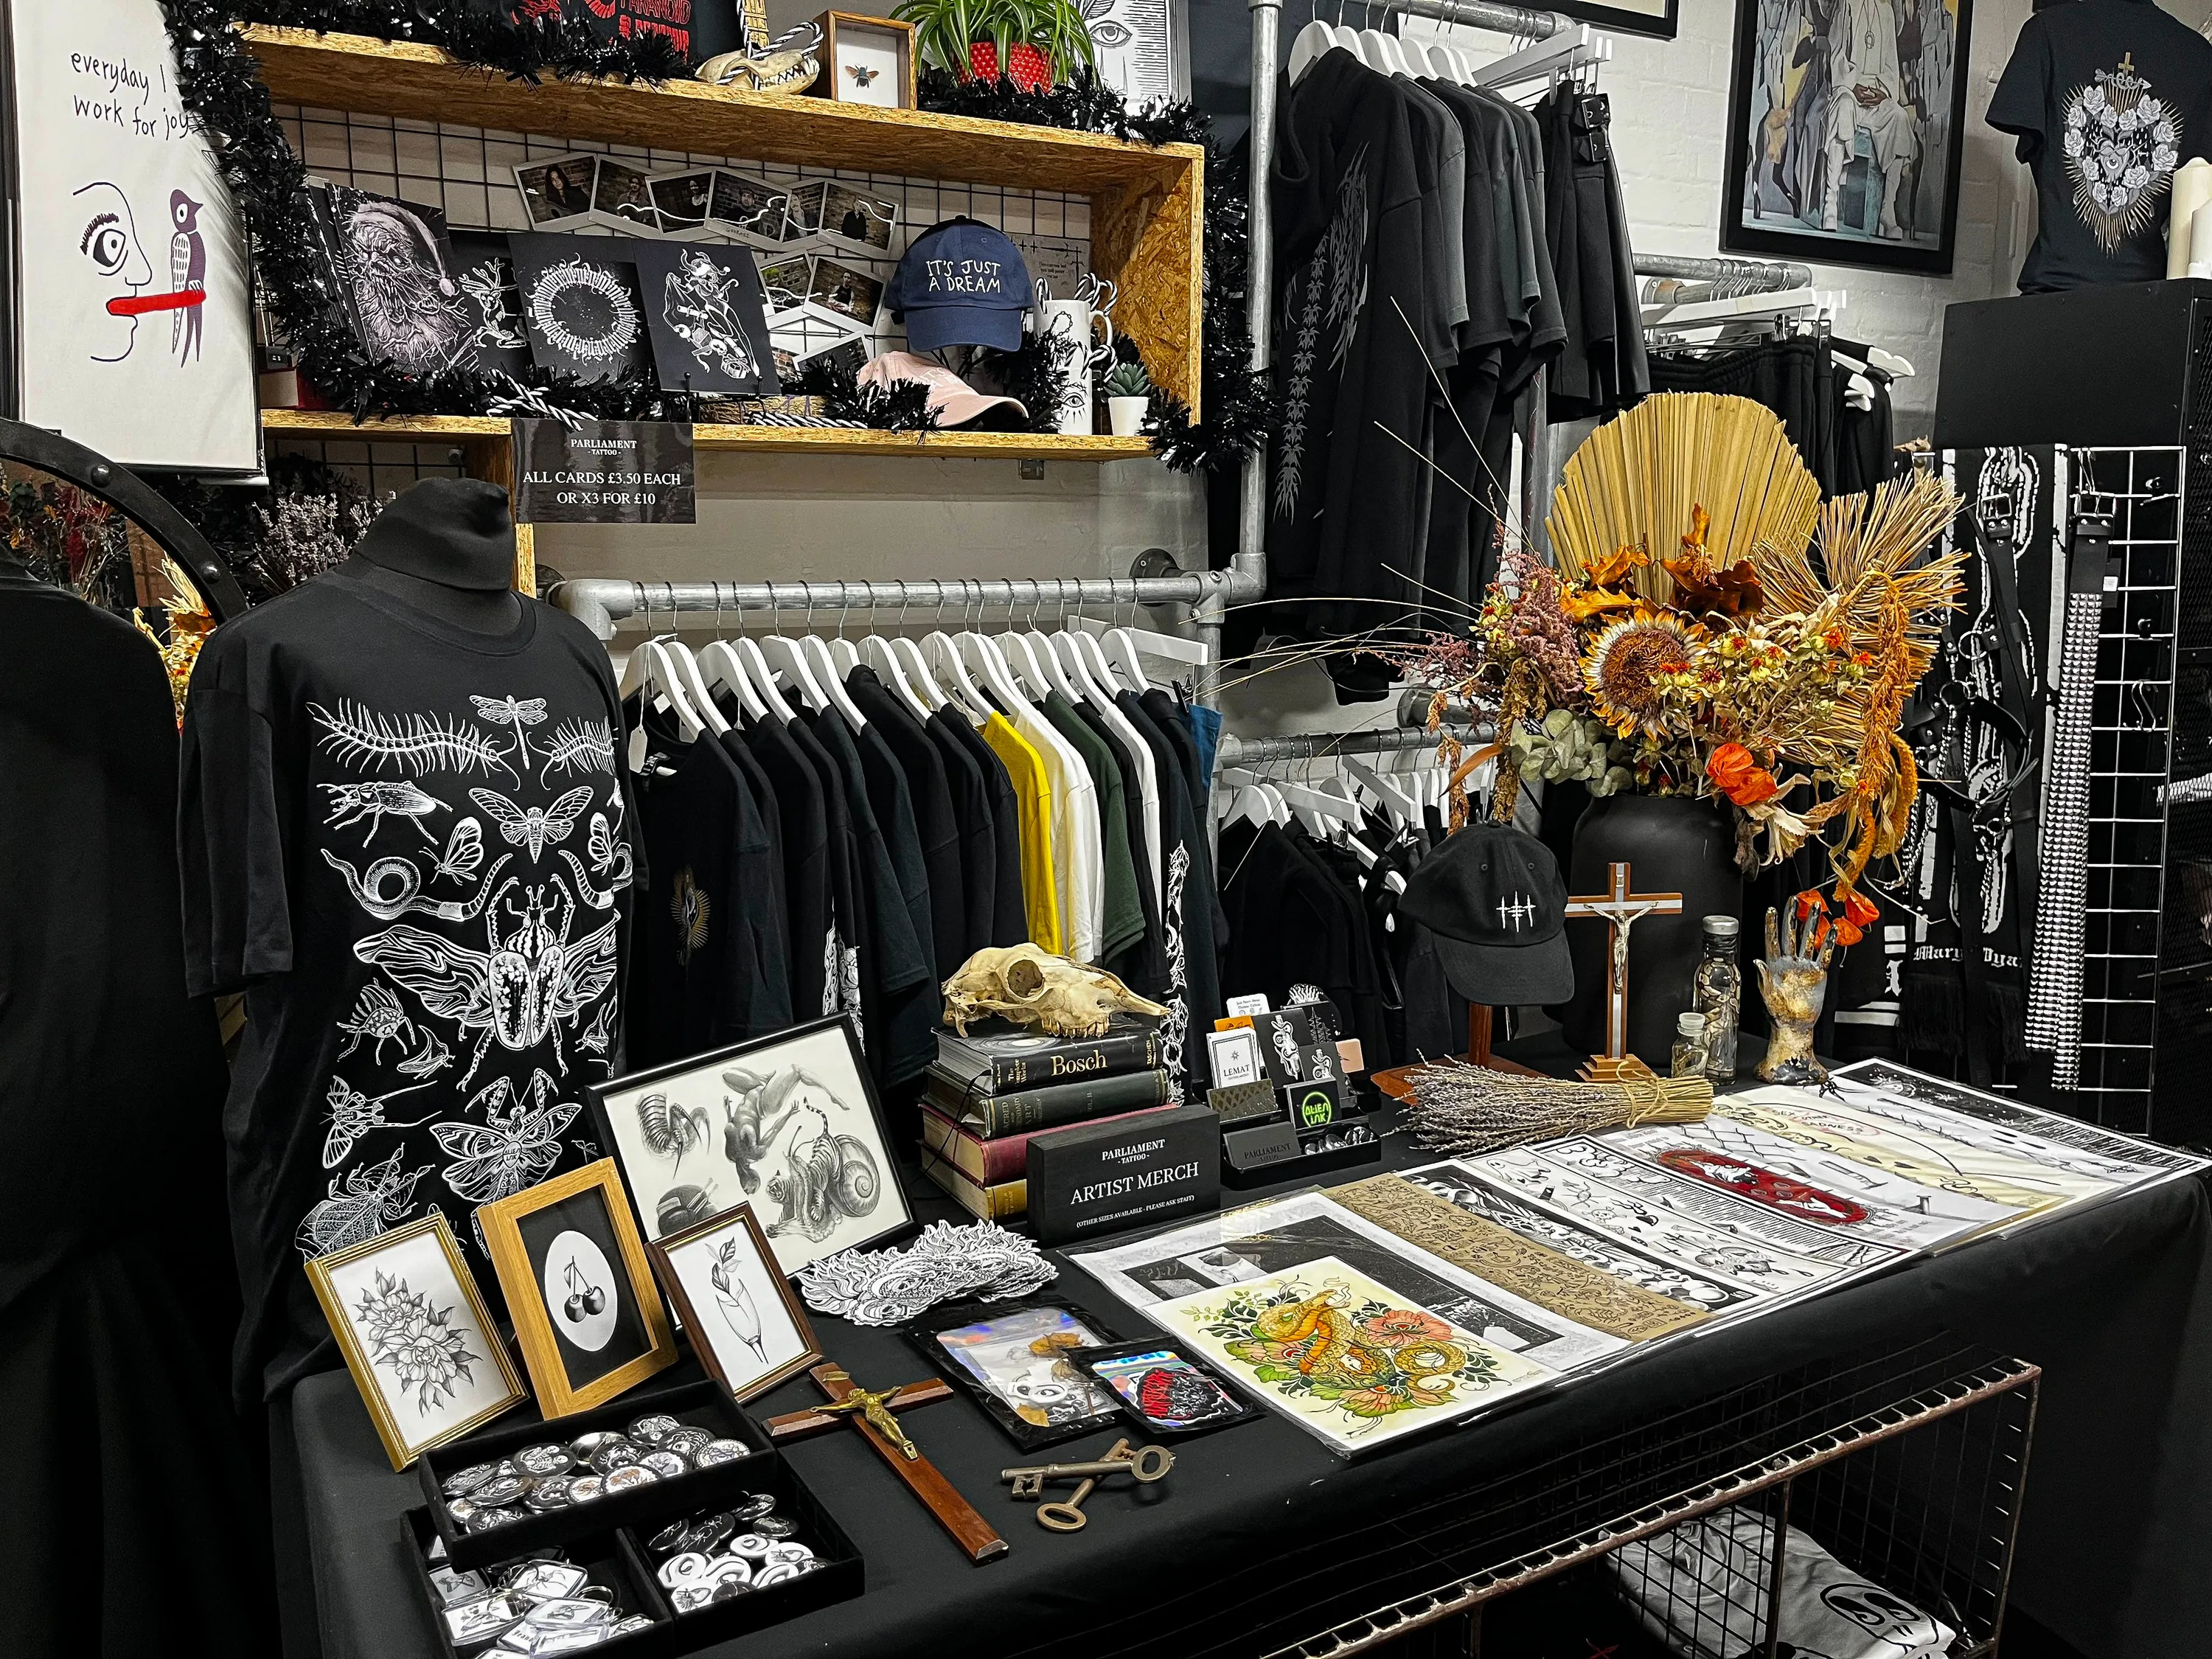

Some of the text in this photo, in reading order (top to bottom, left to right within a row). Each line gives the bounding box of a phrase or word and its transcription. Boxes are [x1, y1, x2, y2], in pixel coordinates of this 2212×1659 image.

[71, 53, 149, 105] everyday
[74, 94, 189, 141] work for joy
[926, 260, 1001, 276] IT'S JUST
[929, 275, 1001, 293] A DREAM
[571, 439, 637, 449] PARLIAMENT
[523, 471, 681, 485] ALL CARDS £3.50 EACH
[557, 493, 655, 505] OR X3 FOR £10
[1913, 945, 1963, 961] Mary
[1050, 1050, 1107, 1077] Bosch
[1223, 1064, 1251, 1077] LEMAT
[1102, 1138, 1165, 1161] PARLIAMENT
[1243, 1143, 1291, 1159] PARLIAMENT
[1071, 1161, 1199, 1205] ARTIST MERCH
[1077, 1215, 1099, 1228] (OTHER
[1098, 1213, 1114, 1223] SIZES
[1113, 1207, 1143, 1220] AVAILABLE
[1146, 1202, 1166, 1211] PLEASE
[1165, 1198, 1177, 1207] ASK
[1176, 1194, 1194, 1205] STAFF)
